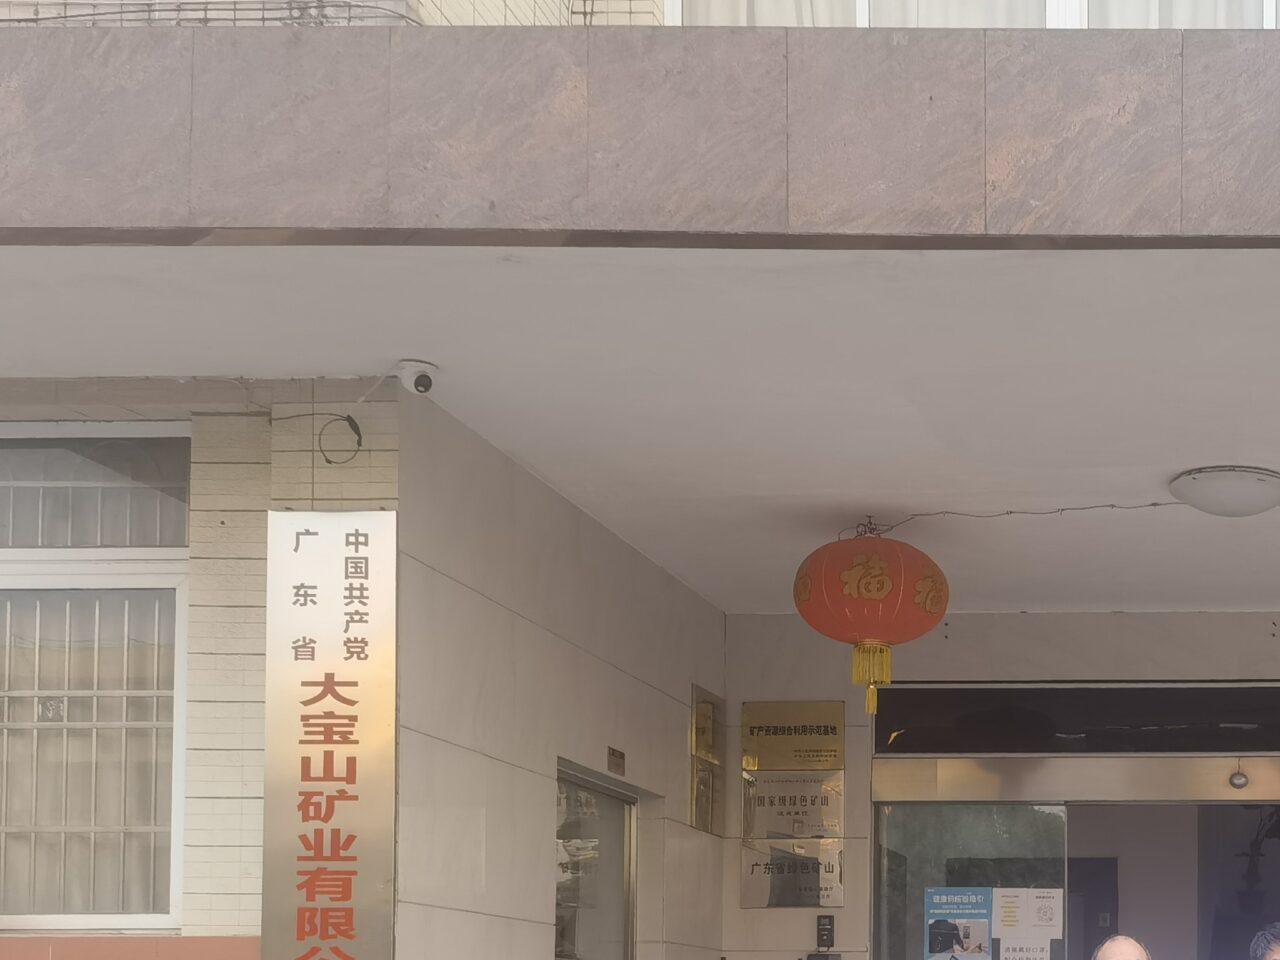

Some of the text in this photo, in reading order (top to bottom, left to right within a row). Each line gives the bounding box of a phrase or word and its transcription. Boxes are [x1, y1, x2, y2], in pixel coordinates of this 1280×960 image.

[291, 529, 319, 661] 广东省
[343, 529, 369, 661] 中国共产党
[839, 553, 893, 600] 福
